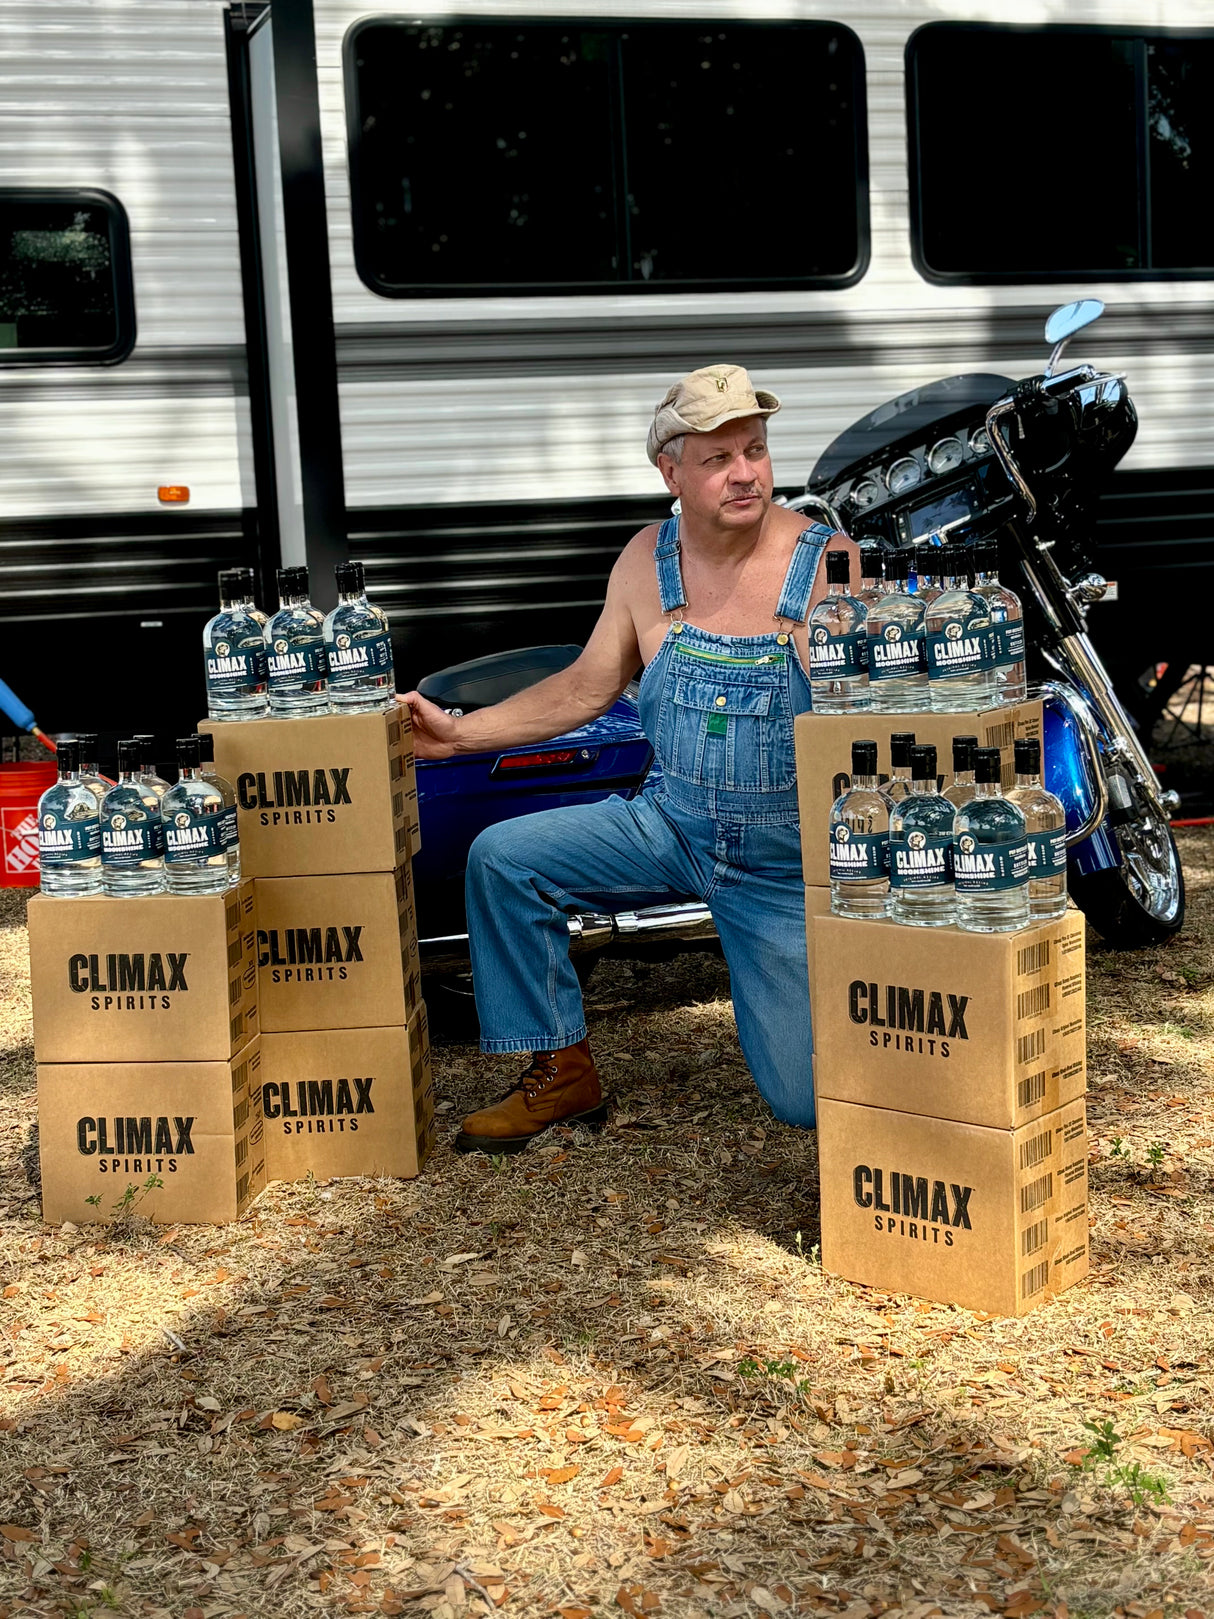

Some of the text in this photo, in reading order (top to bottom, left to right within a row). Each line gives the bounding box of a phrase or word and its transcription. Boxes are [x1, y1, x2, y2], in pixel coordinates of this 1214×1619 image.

[329, 646, 368, 668] CLIMAX
[810, 643, 845, 661] CLIMAX
[874, 640, 919, 662] CLIMAX
[935, 637, 981, 660] CLIMAX
[208, 655, 248, 673] CLIMAX
[268, 652, 306, 672] CLIMAX
[875, 656, 920, 668] MOONSHINE
[936, 654, 982, 666] MOONSHINE
[237, 768, 352, 810] CLIMAX
[260, 810, 336, 825] SPIRITS
[103, 829, 144, 846] CLIMAX
[167, 826, 208, 846] CLIMAX
[830, 844, 868, 860] CLIMAX
[896, 848, 945, 868] CLIMAX
[898, 866, 945, 875] MOONSHINE
[954, 854, 995, 872] CLIMAX
[258, 926, 364, 966] CLIMAX
[68, 953, 189, 993] CLIMAX
[272, 966, 347, 983] SPIRITS
[91, 995, 171, 1010] SPIRITS
[848, 980, 970, 1040] CLIMAX
[870, 1030, 950, 1057] SPIRITS
[262, 1077, 374, 1120] CLIMAX
[77, 1116, 196, 1156] CLIMAX
[283, 1118, 358, 1134] SPIRITS
[99, 1158, 178, 1173] SPIRITS
[853, 1164, 973, 1230] CLIMAX
[875, 1215, 954, 1246] SPIRITS
